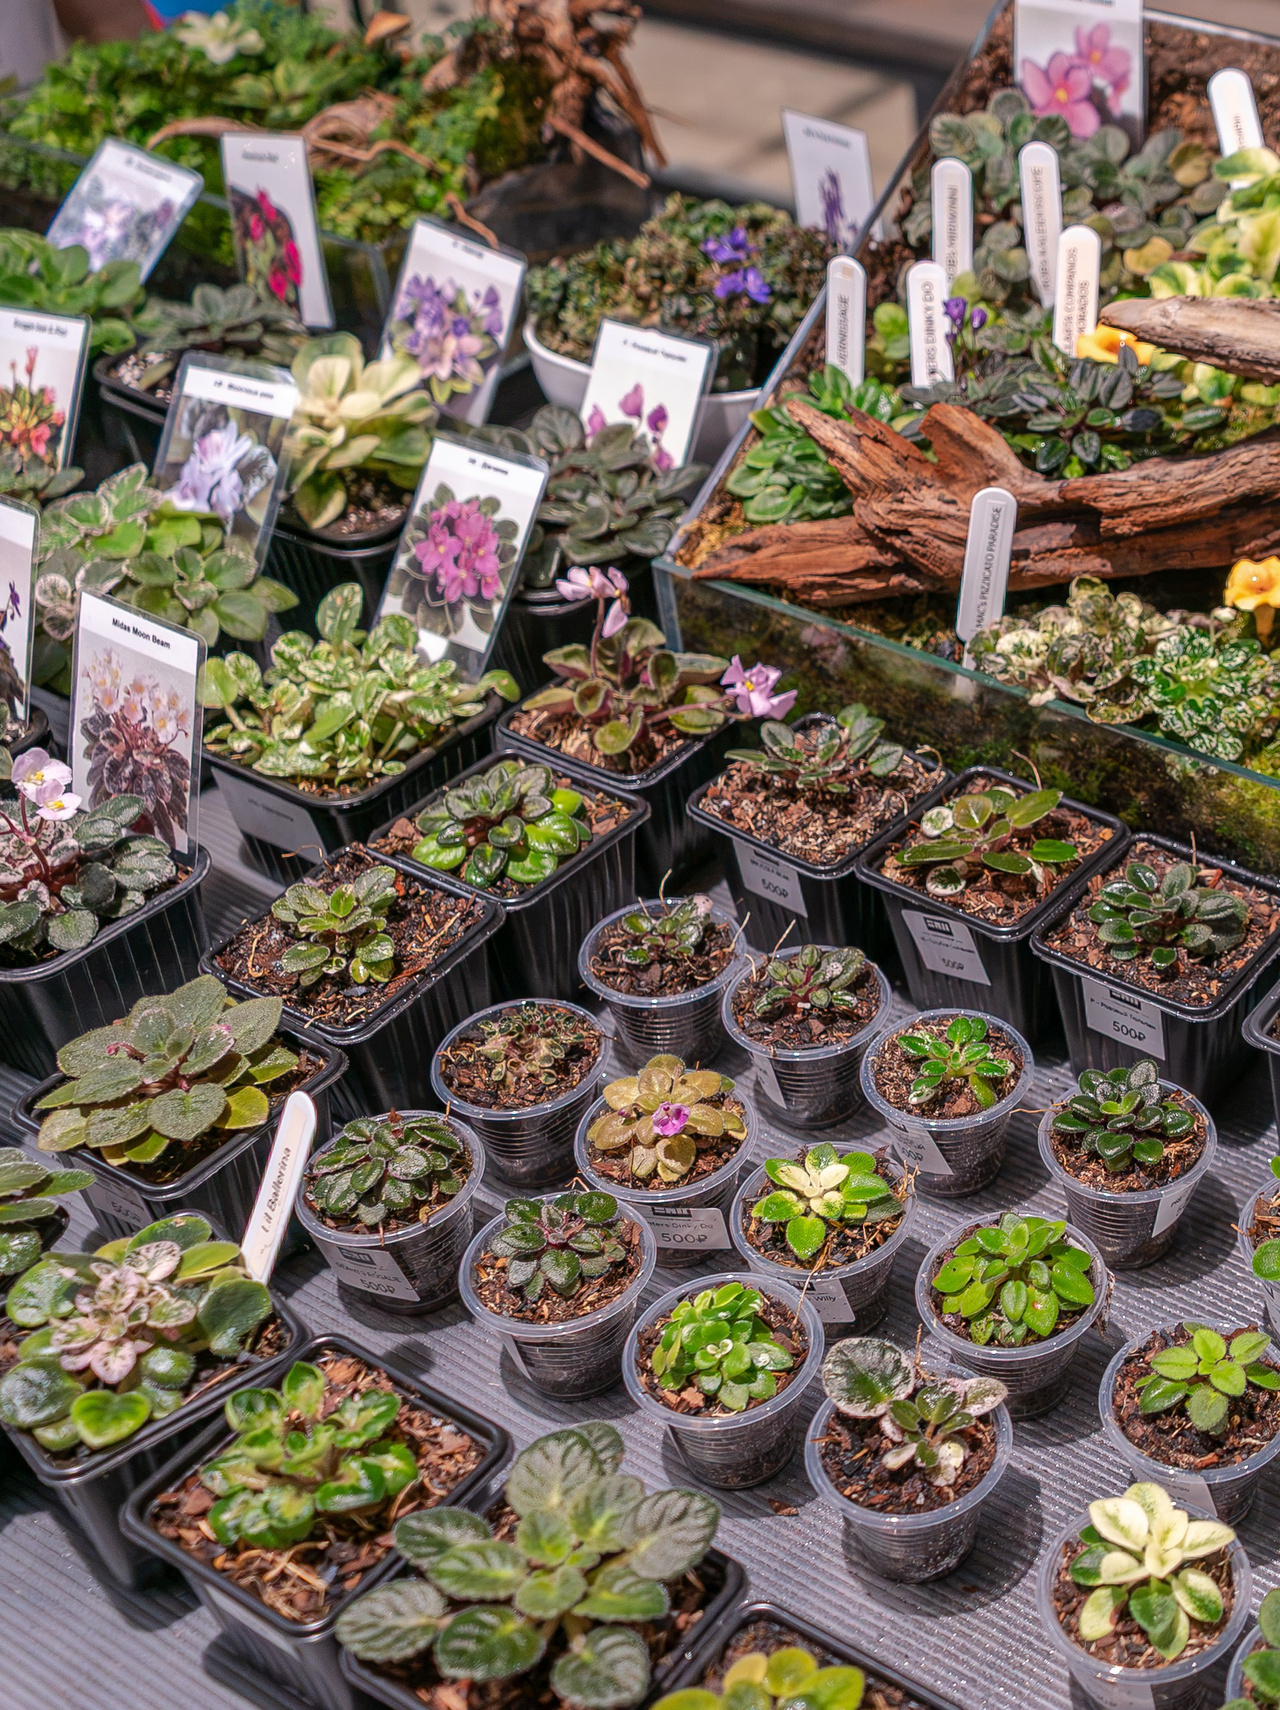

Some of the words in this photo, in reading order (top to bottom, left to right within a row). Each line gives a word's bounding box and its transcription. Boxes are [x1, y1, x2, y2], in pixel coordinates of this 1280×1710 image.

[986, 507, 1002, 552] PARADISE
[112, 617, 131, 633] Midas
[132, 626, 150, 642] Moon
[152, 634, 171, 650] Beam
